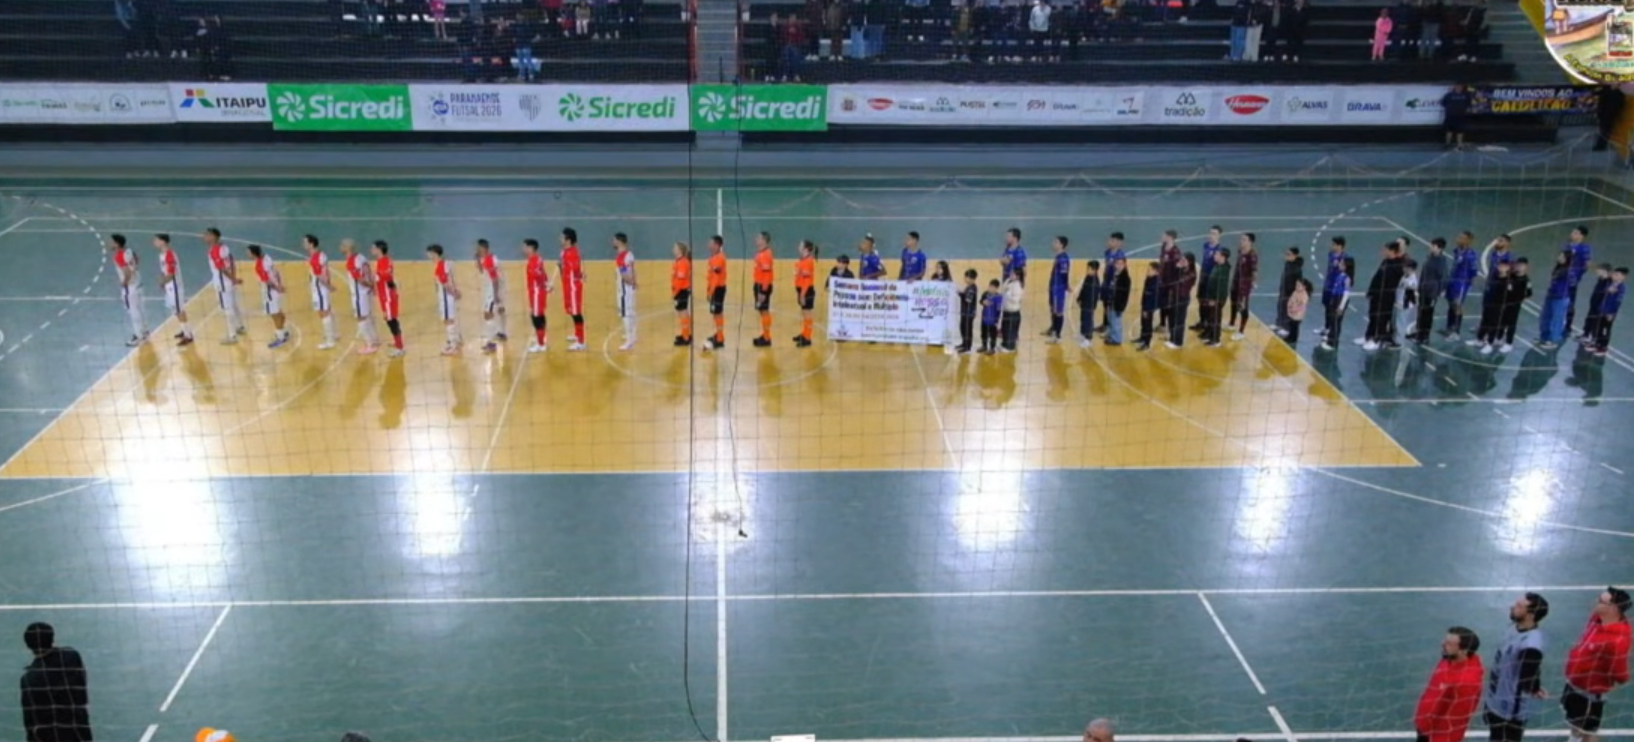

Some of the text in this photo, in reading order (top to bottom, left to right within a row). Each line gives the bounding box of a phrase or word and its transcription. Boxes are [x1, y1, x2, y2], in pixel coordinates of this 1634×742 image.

[1493, 89, 1574, 98] BEM VINDOS AO
[216, 97, 266, 108] ITAIPU
[309, 95, 404, 119] Sicredi
[588, 97, 676, 119] Sicredi
[729, 95, 822, 119] Sicredi
[451, 104, 502, 117] FUTSAL 2026
[1164, 107, 1206, 117] tradição
